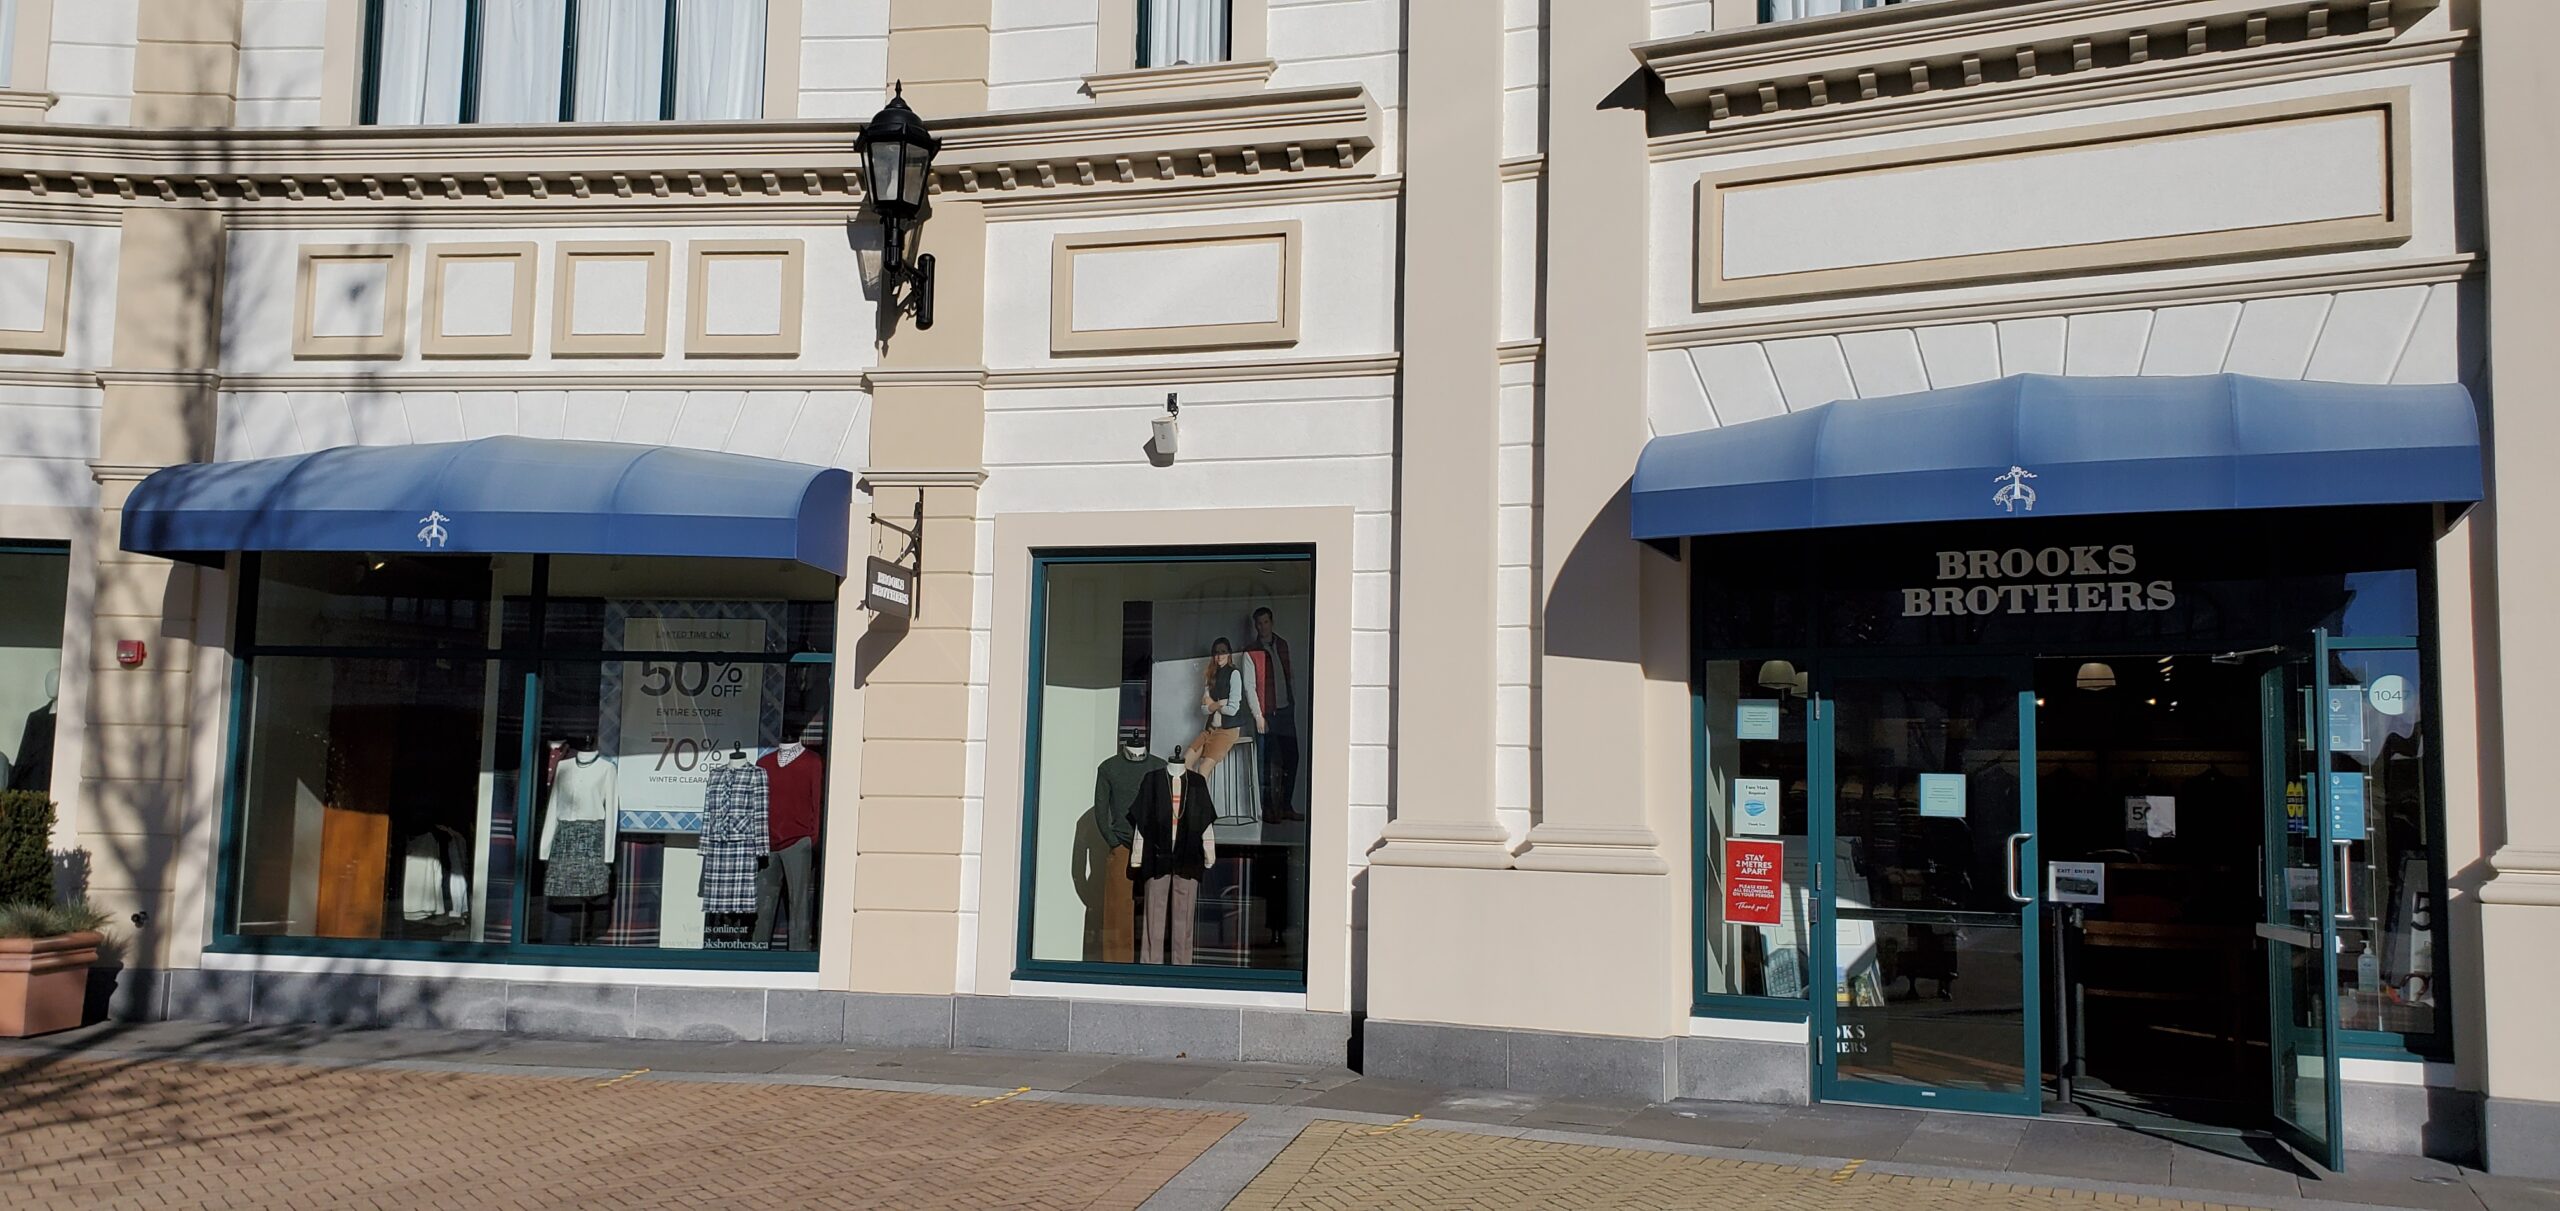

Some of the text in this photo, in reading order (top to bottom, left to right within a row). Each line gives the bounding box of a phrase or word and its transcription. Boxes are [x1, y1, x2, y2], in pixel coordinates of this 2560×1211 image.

[1936, 544, 2137, 580] BROOKS
[877, 571, 905, 591] BROOKS
[872, 583, 909, 605] BROTHERS
[1901, 580, 2176, 617] BROTHERS
[656, 631, 731, 640] LTED TIME ONLY
[640, 650, 743, 697] 50%
[711, 684, 743, 698] OFF
[656, 708, 723, 718] ENTIRE STORE
[651, 737, 722, 772] 70%
[679, 776, 709, 784] CLEARA
[1741, 861, 1773, 869] METRES
[712, 923, 739, 934] online
[740, 926, 748, 934] at
